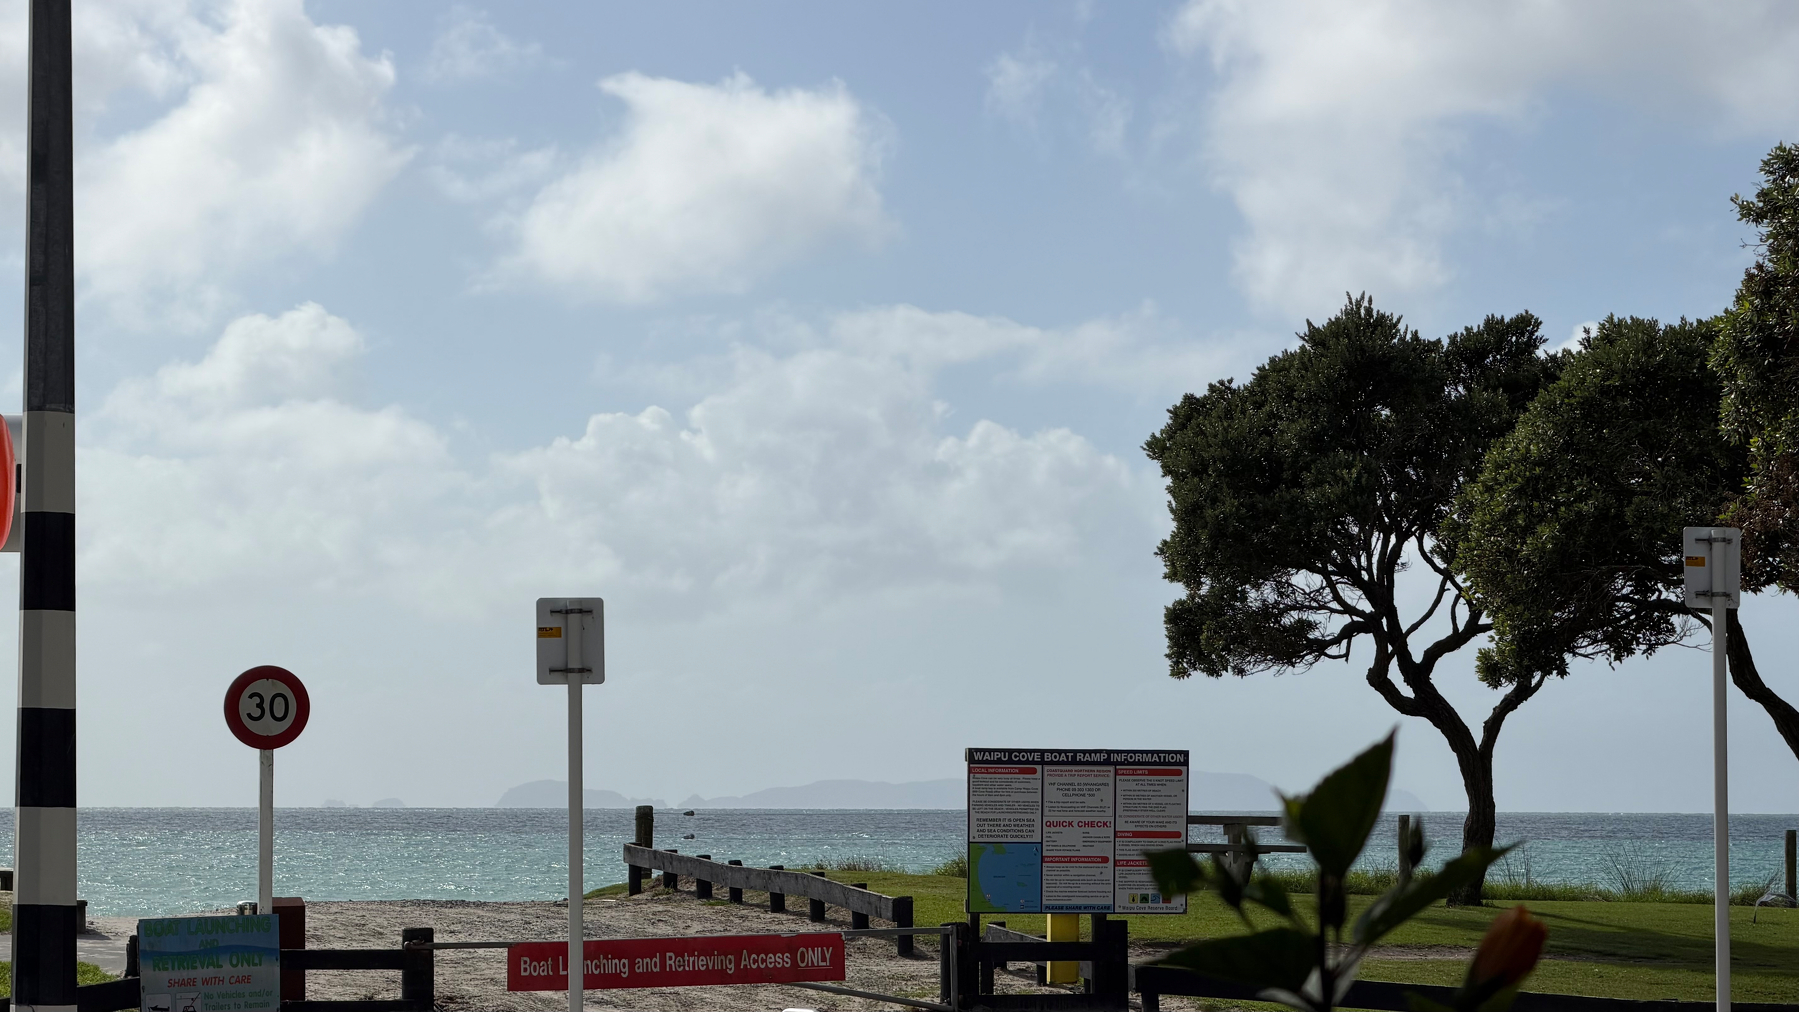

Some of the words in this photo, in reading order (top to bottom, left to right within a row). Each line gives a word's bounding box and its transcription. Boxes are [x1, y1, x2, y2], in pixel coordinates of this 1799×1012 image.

[246, 692, 289, 722] 30
[974, 752, 1008, 761] WAIPU
[1012, 752, 1041, 761] COVE
[1044, 752, 1073, 761] BOAT
[1077, 753, 1107, 762] RAMP
[1111, 753, 1184, 763] INFORMATION
[144, 920, 181, 937] BOAT
[187, 916, 272, 935] LAUNCHING
[199, 939, 219, 949] AND
[152, 954, 223, 972] RETRIEVAL
[229, 951, 265, 968] ONLY
[520, 956, 553, 977] Boat
[559, 952, 629, 977] Lnching
[635, 953, 660, 973] and
[666, 950, 735, 975] Retrieving
[740, 949, 791, 969] Access
[796, 947, 833, 968] ONLY
[167, 978, 197, 988] SHARE
[201, 976, 224, 986] WITH
[228, 975, 251, 985] CARE
[248, 989, 273, 998] and/or
[204, 1003, 231, 1011] Trailers
[244, 1001, 270, 1009] Remain
